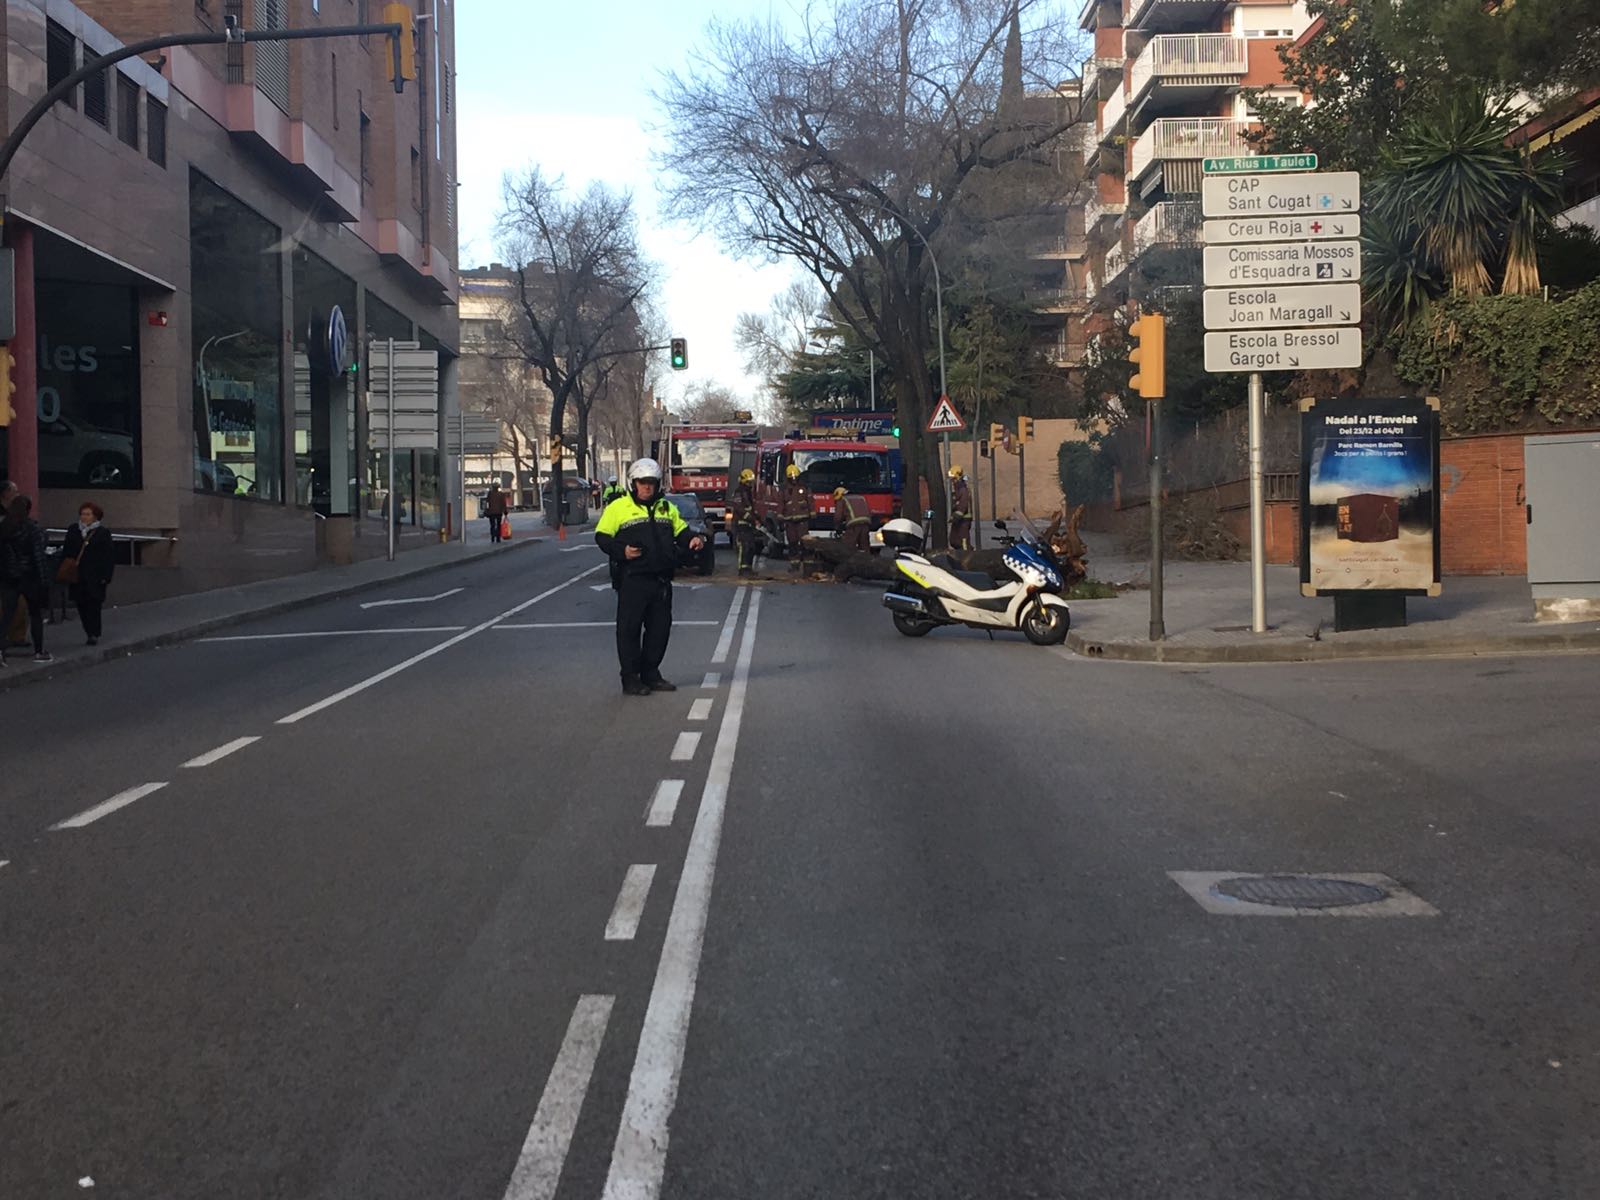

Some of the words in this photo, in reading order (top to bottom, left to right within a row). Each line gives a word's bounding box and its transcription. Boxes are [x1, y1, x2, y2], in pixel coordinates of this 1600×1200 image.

[1210, 160, 1229, 170] Av.
[1234, 157, 1259, 168] Rius
[1273, 155, 1311, 167] Taulet
[1228, 178, 1260, 193] CAP
[1228, 196, 1261, 210] Sant
[1267, 194, 1311, 211] Cugat
[1228, 222, 1263, 236] Creu
[1269, 221, 1302, 237] Roja
[1229, 247, 1299, 262] Comissaria
[1304, 245, 1354, 260] Mossos
[1229, 264, 1311, 281] d'Esquadra
[1228, 290, 1277, 305] Escola
[1229, 309, 1264, 323] Joan
[1270, 305, 1333, 322] Maragall
[1229, 334, 1277, 348] Escola
[1284, 331, 1340, 347] Bressol
[1230, 351, 1281, 368] Gargot
[1325, 416, 1358, 425] Nadal
[1368, 415, 1418, 424] l'Envelat
